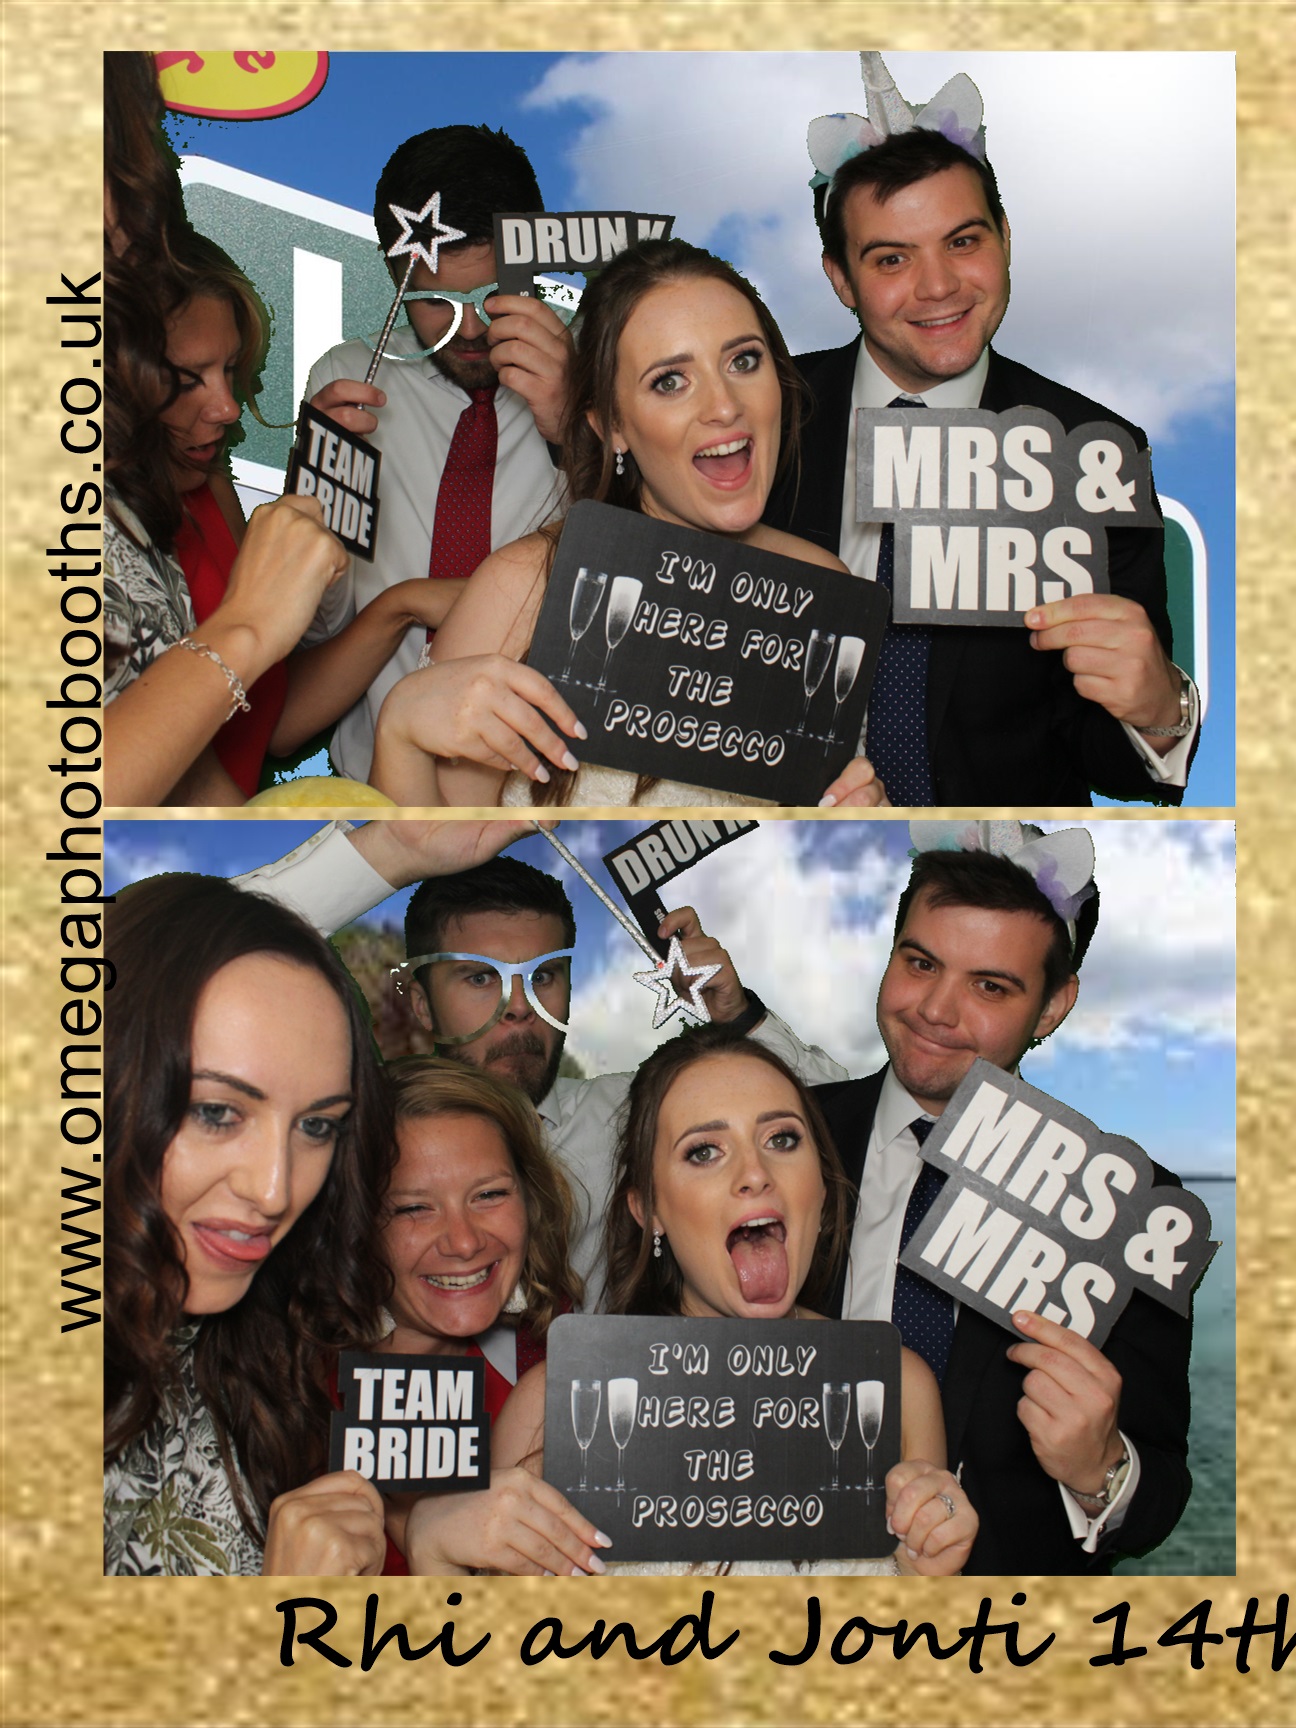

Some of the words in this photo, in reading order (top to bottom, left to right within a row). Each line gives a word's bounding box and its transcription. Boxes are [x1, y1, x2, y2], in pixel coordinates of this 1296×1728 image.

[307, 419, 375, 500] TEAM
[873, 425, 1053, 512] MRS
[1075, 439, 1137, 514] &
[655, 551, 717, 594] I'M
[730, 571, 814, 618] ONLY
[910, 525, 1094, 612] MRS
[633, 600, 728, 650] HERE
[740, 629, 804, 671] FOR
[668, 665, 734, 707] THE
[604, 699, 786, 767] PROSECCO
[940, 1080, 1137, 1240] MRS
[1124, 1205, 1194, 1291] &
[920, 1187, 1116, 1339] MRS
[648, 1343, 710, 1375] I'M
[727, 1344, 817, 1376] ONLY
[353, 1368, 474, 1420] TEAM
[638, 1396, 735, 1428] HERE
[753, 1397, 820, 1428] FOR
[343, 1426, 479, 1480] BRIDE
[684, 1450, 754, 1481] THE
[632, 1495, 824, 1528] PROSECCO
